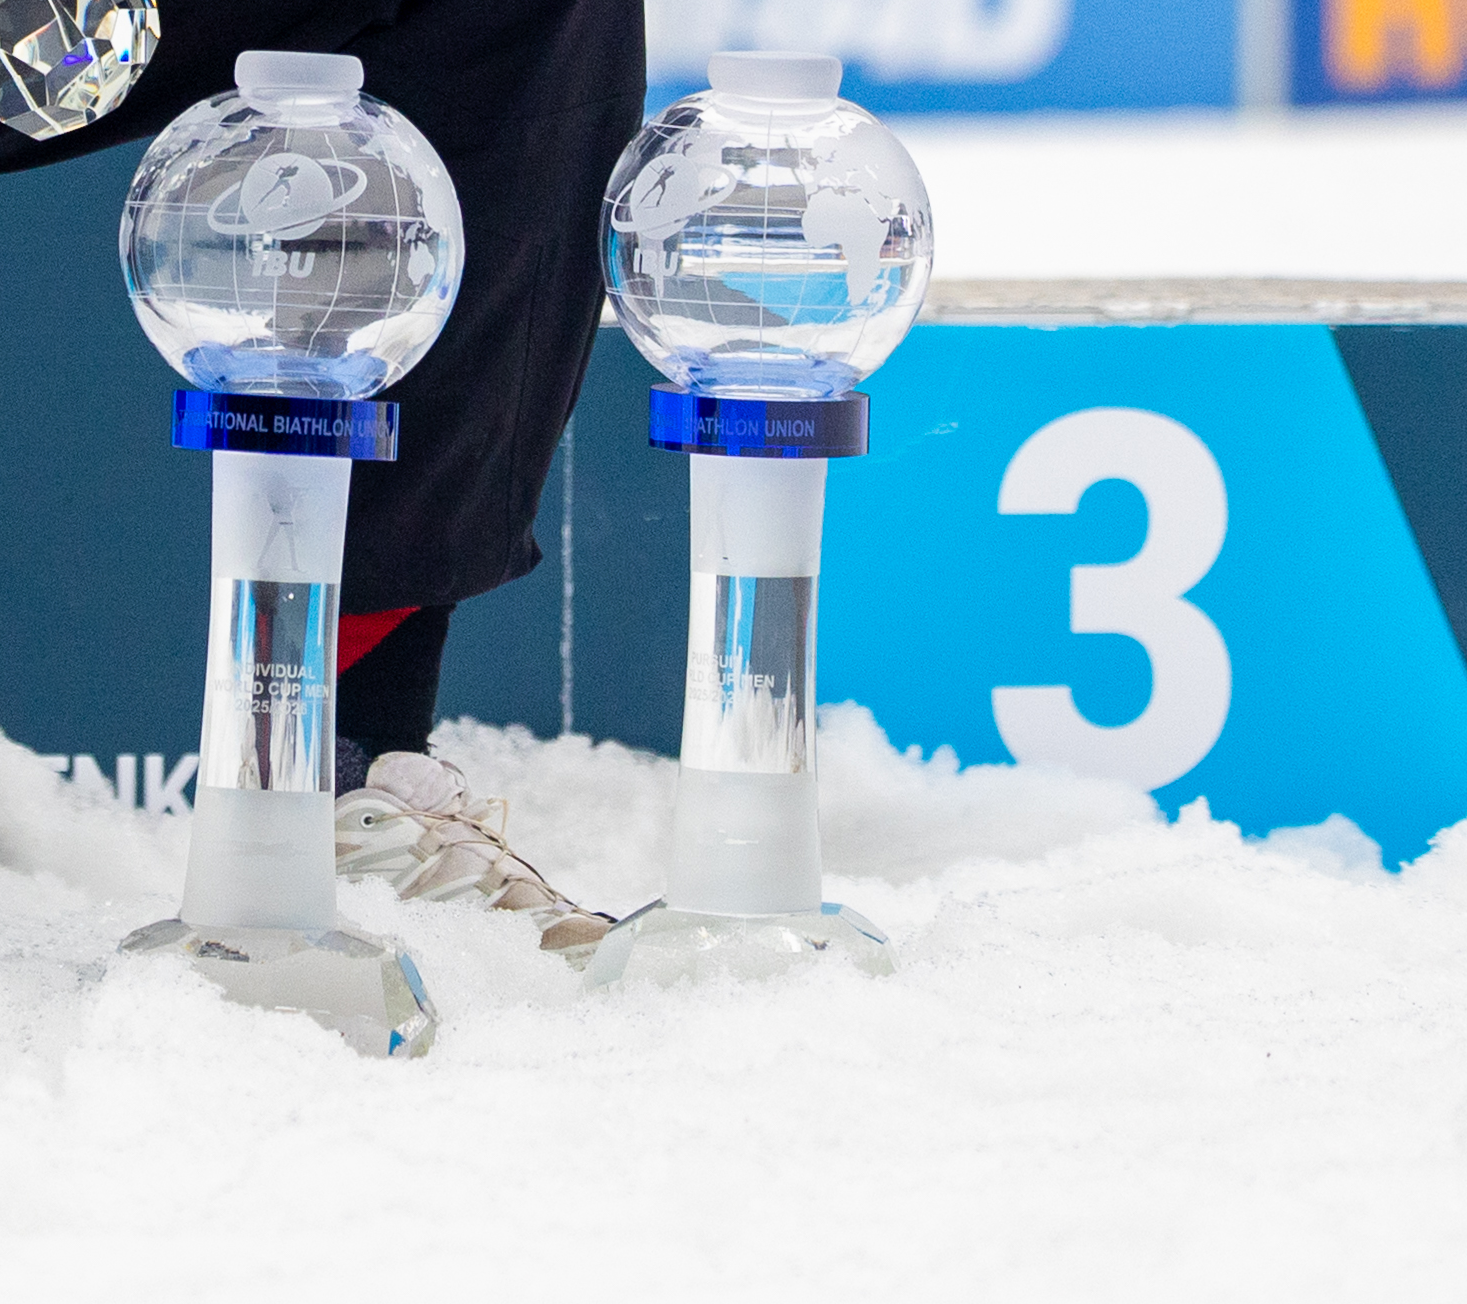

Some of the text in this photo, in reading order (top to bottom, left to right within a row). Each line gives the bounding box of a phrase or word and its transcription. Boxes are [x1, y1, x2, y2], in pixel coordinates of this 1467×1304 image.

[251, 250, 316, 279] IBU
[273, 415, 354, 437] BIATHLON
[764, 419, 816, 438] UNION
[991, 406, 1233, 793] 3
[268, 681, 302, 697] CUP
